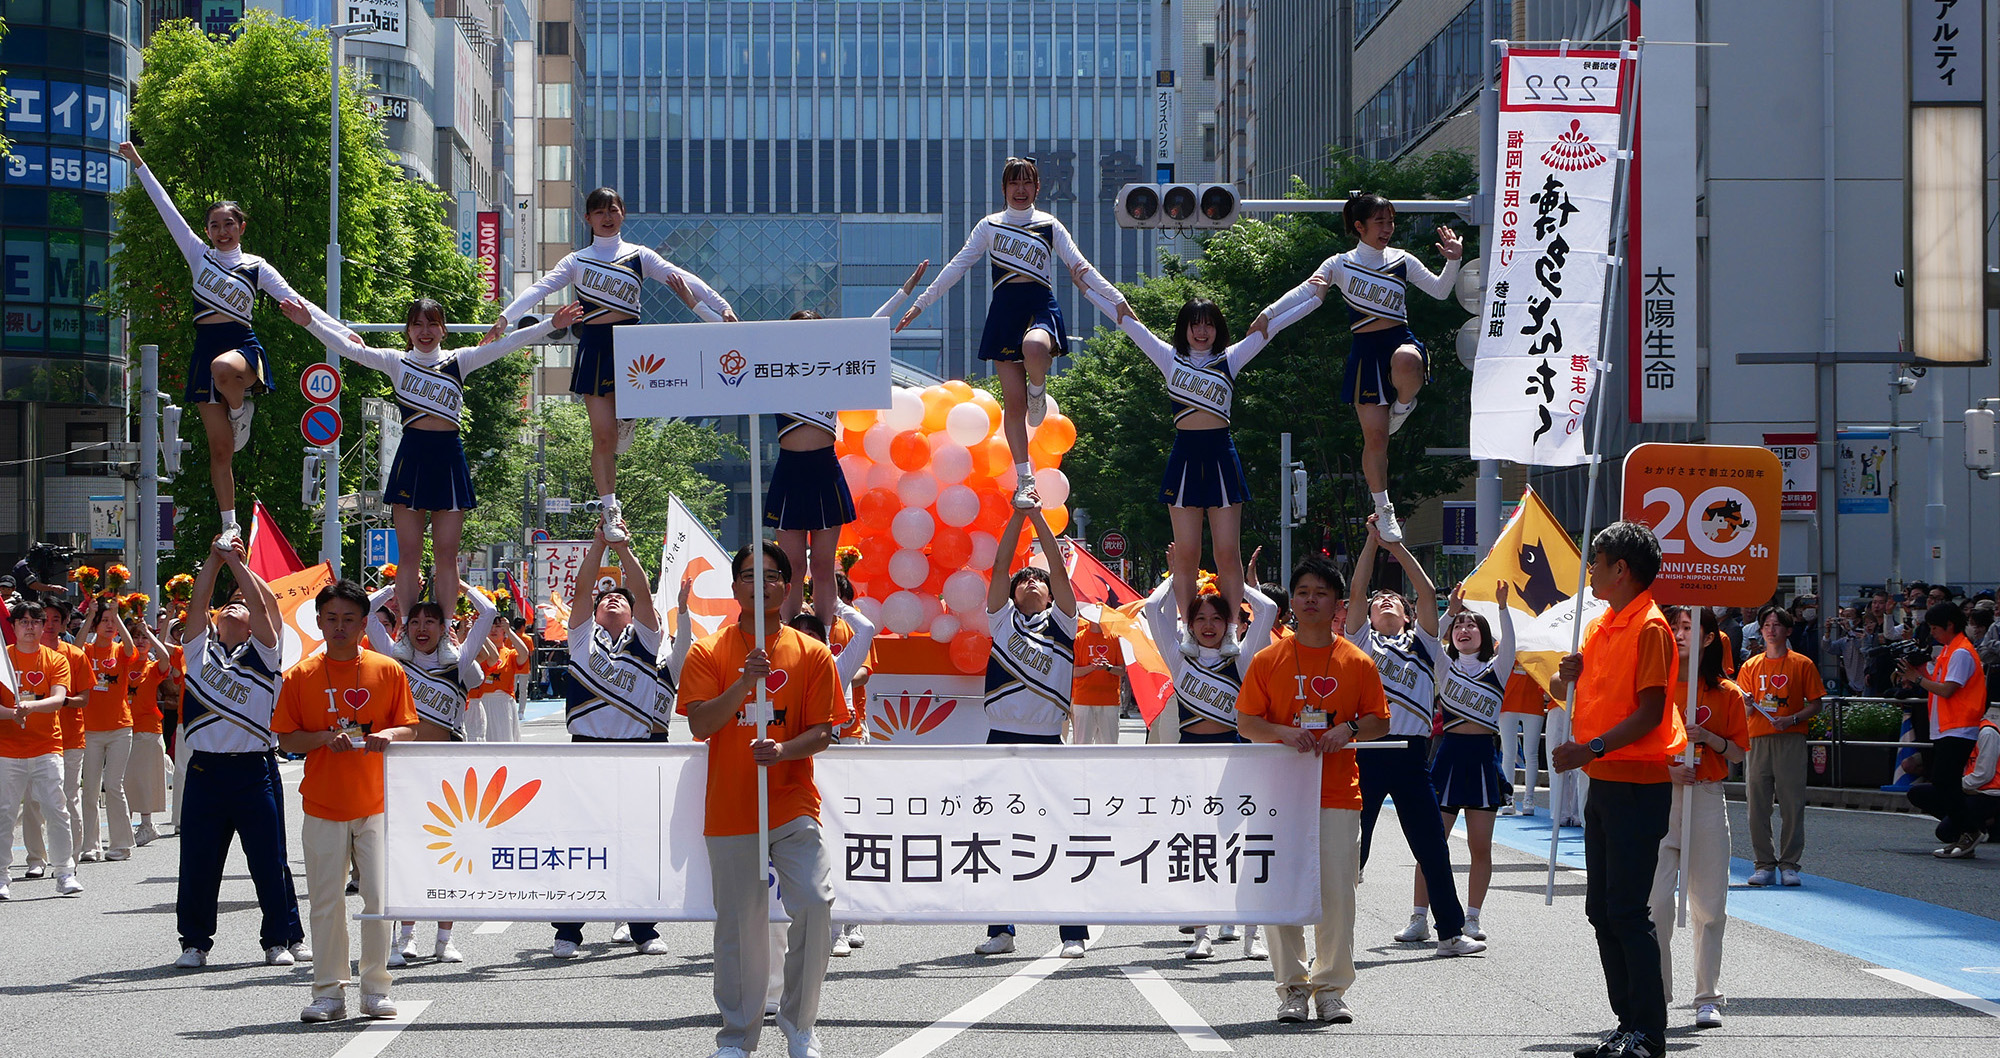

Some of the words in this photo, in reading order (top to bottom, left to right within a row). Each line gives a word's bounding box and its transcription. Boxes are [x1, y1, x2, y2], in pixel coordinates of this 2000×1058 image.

[9, 88, 107, 132] エイワ
[993, 233, 1047, 270] WILDCATS
[197, 268, 251, 312] WILDCATS
[581, 268, 640, 304] WILDCATS
[1347, 276, 1404, 311] WILDCATS
[1644, 266, 1676, 391] 太陽生命
[310, 375, 332, 393] 40
[401, 371, 460, 411] WILDCATS
[649, 379, 688, 389] 西日本FH
[754, 359, 876, 379] 西日本シティ銀行
[1170, 368, 1228, 407] WILDCATS
[1644, 465, 1765, 479] おかげさまで創立20周年
[1105, 540, 1124, 550] 消火栓
[546, 547, 560, 592] ストリ
[1658, 562, 1747, 575] NNIVERSARY
[201, 662, 251, 705] WILDCATS
[1181, 672, 1236, 714] WILDCATS
[1294, 675, 1307, 700] I
[1443, 677, 1497, 718] WILDCATS
[1759, 674, 1767, 691] I
[324, 688, 339, 713] I
[844, 793, 1278, 818] ココロがある。コタエがある。
[491, 847, 608, 871] 西日本FH
[845, 832, 1276, 884] 西日本シティ銀行
[426, 888, 608, 902] 西日本フィナンシャルホールディングス
